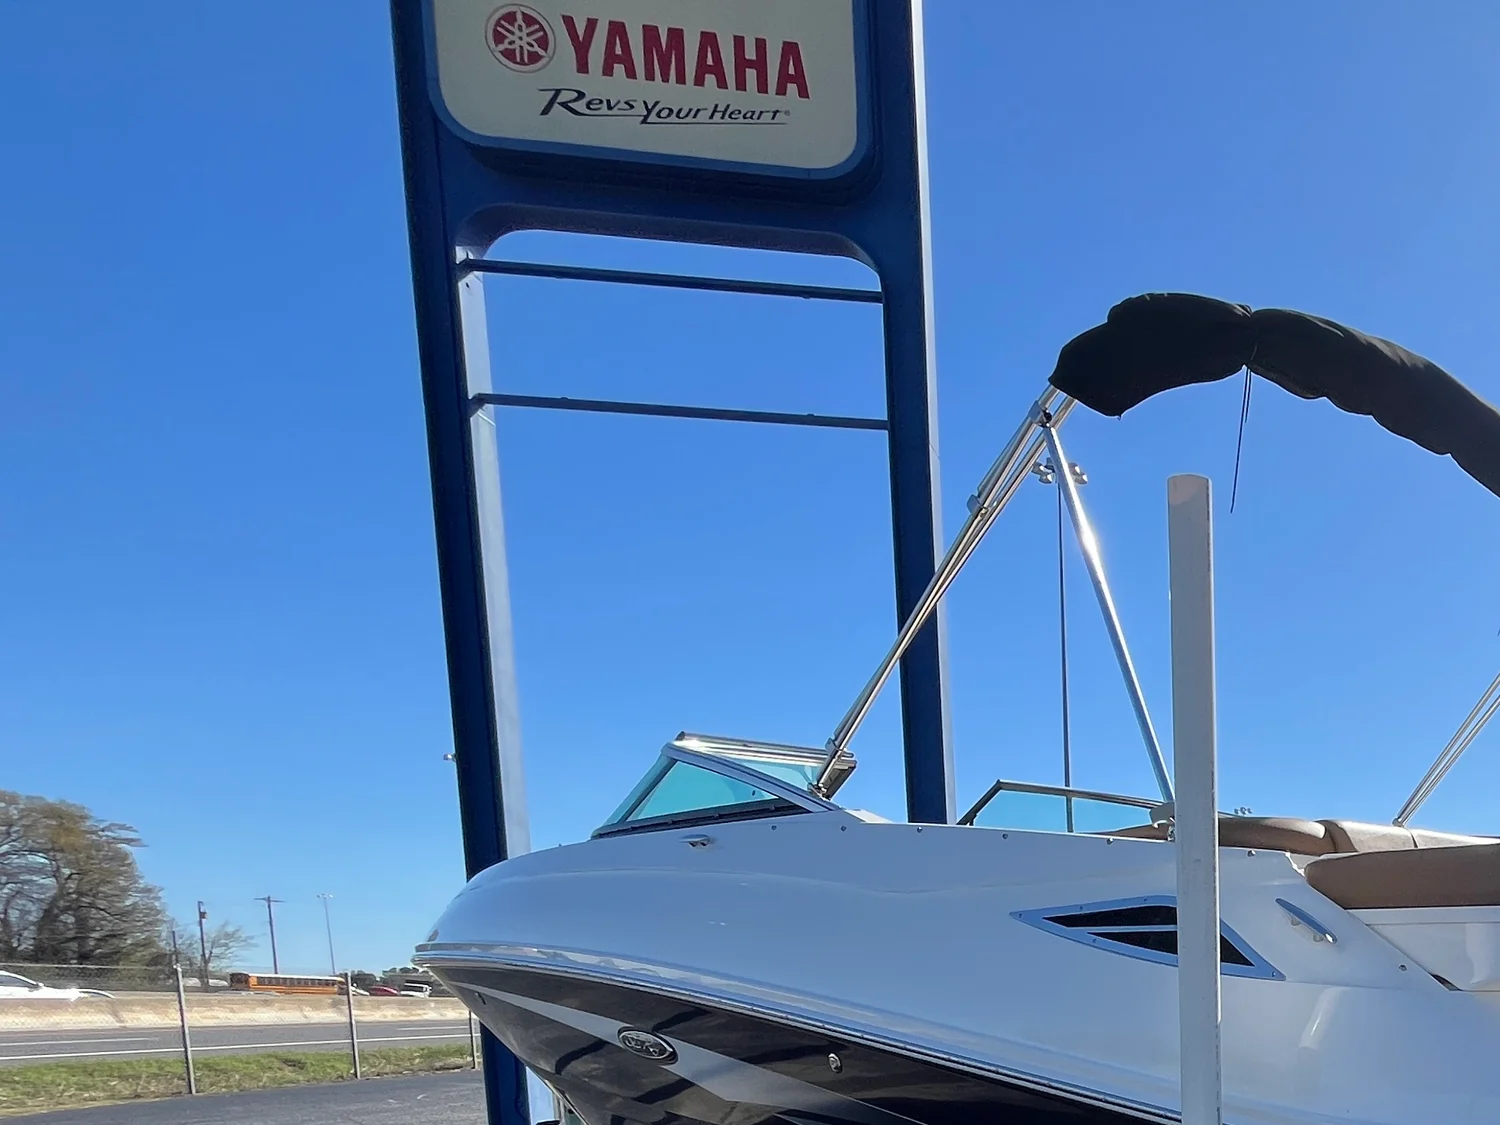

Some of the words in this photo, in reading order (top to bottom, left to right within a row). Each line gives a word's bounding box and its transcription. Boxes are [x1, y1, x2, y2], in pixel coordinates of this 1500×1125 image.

[561, 14, 811, 99] YAMAHA
[538, 88, 639, 117] Revs
[639, 99, 708, 125] Your
[708, 103, 787, 122] Heart
